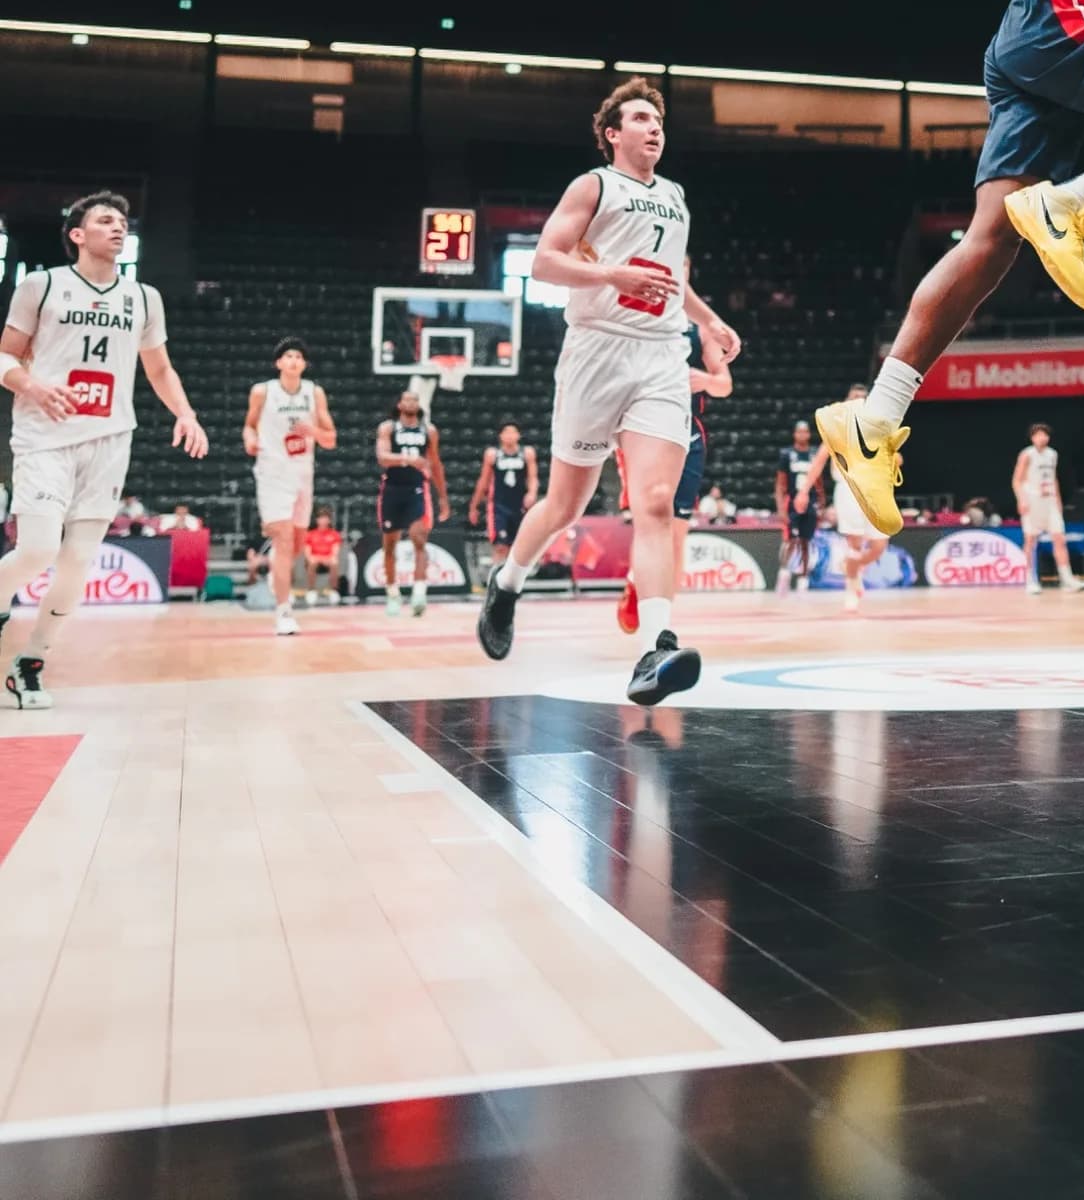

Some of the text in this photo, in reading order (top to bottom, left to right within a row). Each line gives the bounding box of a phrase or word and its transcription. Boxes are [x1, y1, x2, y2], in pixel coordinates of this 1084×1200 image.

[624, 198, 684, 223] JORDAN
[427, 233, 469, 261] 21
[653, 224, 664, 253] 7
[60, 310, 133, 332] JORDAN
[82, 335, 109, 362] 14
[947, 363, 972, 389] la
